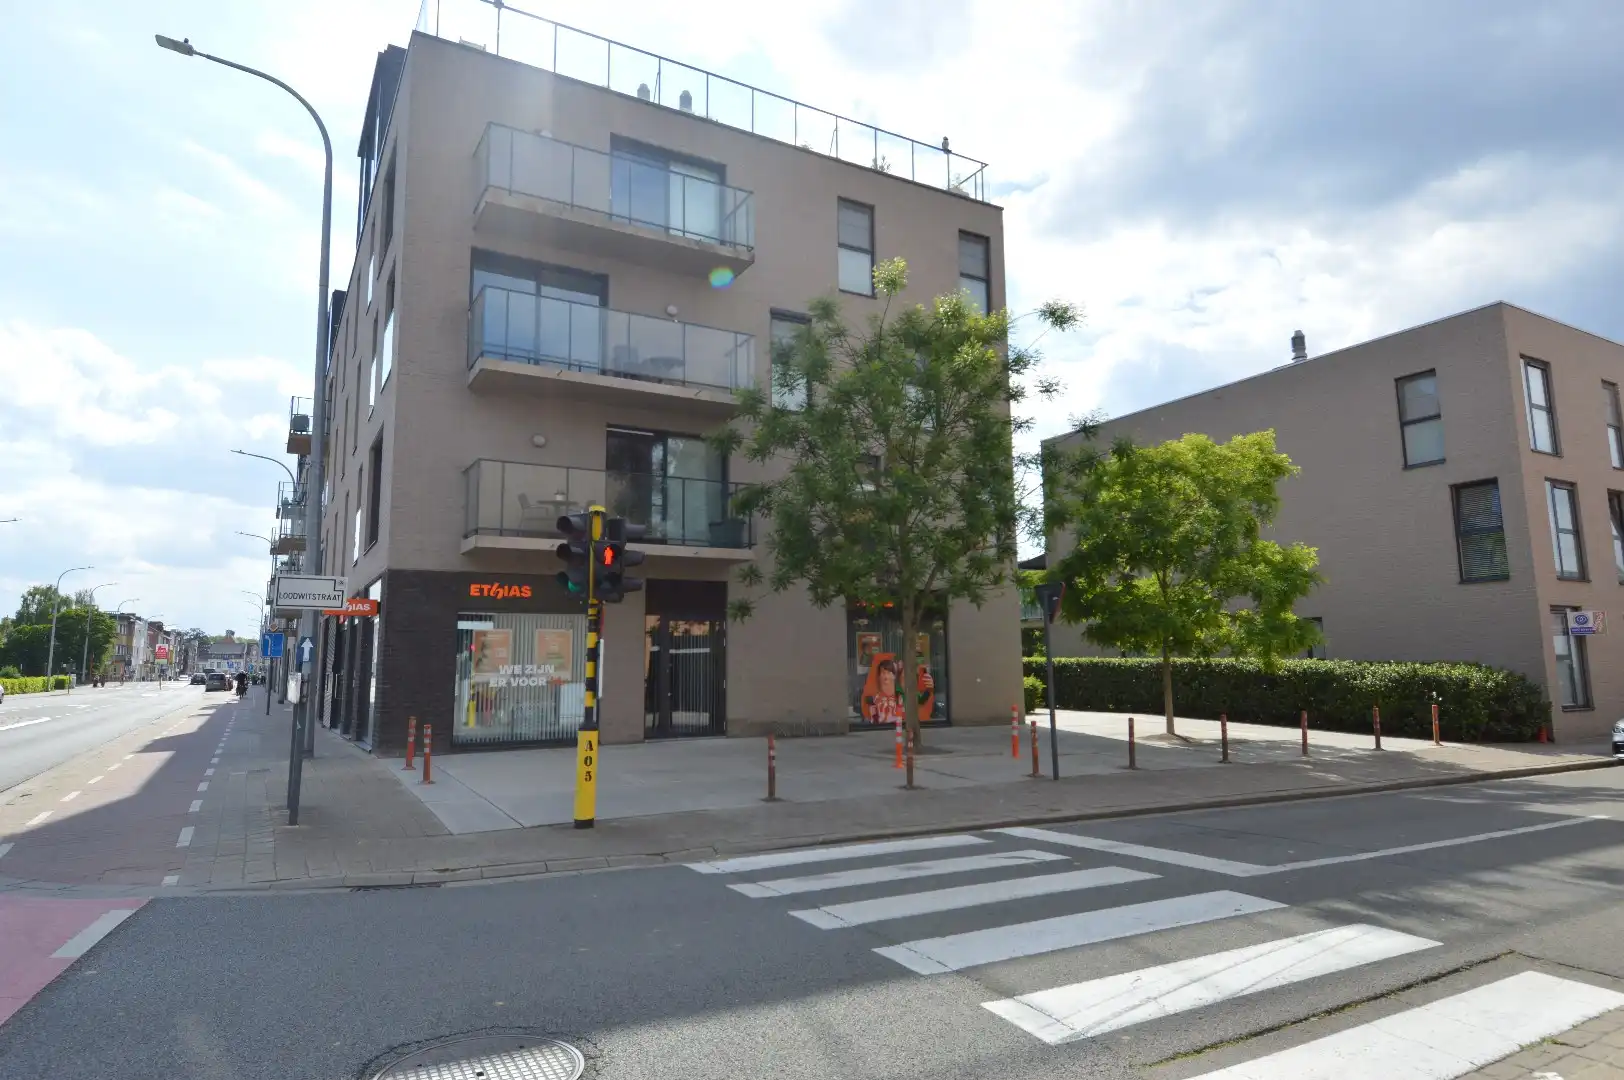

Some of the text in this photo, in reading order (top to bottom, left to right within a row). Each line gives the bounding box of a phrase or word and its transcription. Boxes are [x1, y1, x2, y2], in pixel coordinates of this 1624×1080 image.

[279, 591, 342, 602] LOODWITSTRAAT
[499, 664, 555, 675] WE ZIJN
[489, 677, 507, 688] ER
[510, 676, 548, 687] VOOR
